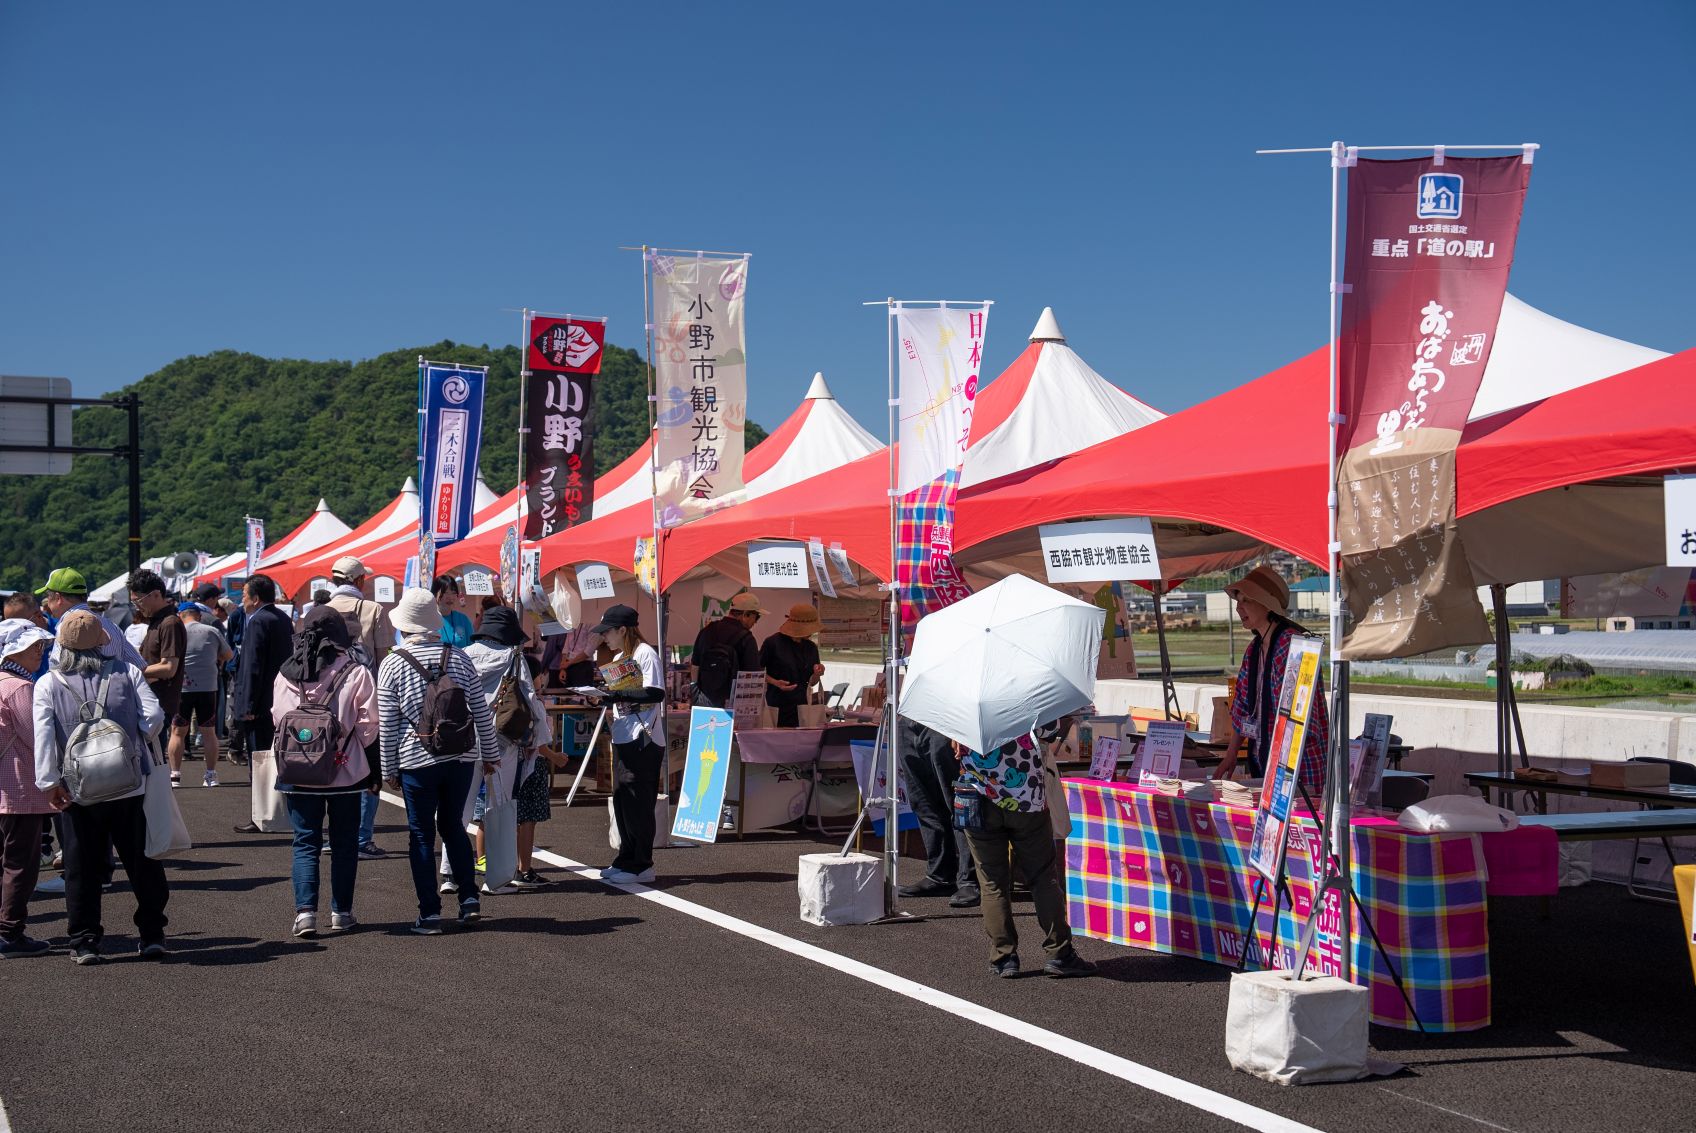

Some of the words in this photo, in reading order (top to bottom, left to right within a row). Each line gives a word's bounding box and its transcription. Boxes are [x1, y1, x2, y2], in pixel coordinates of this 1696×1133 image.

[1371, 237, 1496, 259] 重点「道の駅」
[1408, 224, 1468, 235] 国土交通省選定
[542, 374, 584, 454] 小野
[688, 293, 719, 500] 小野市観光協会
[442, 416, 463, 479] 三木合戦
[438, 486, 452, 530] ゆかりの地
[540, 466, 558, 538] ブランド
[1049, 543, 1152, 568] 西脇市観光物産協会
